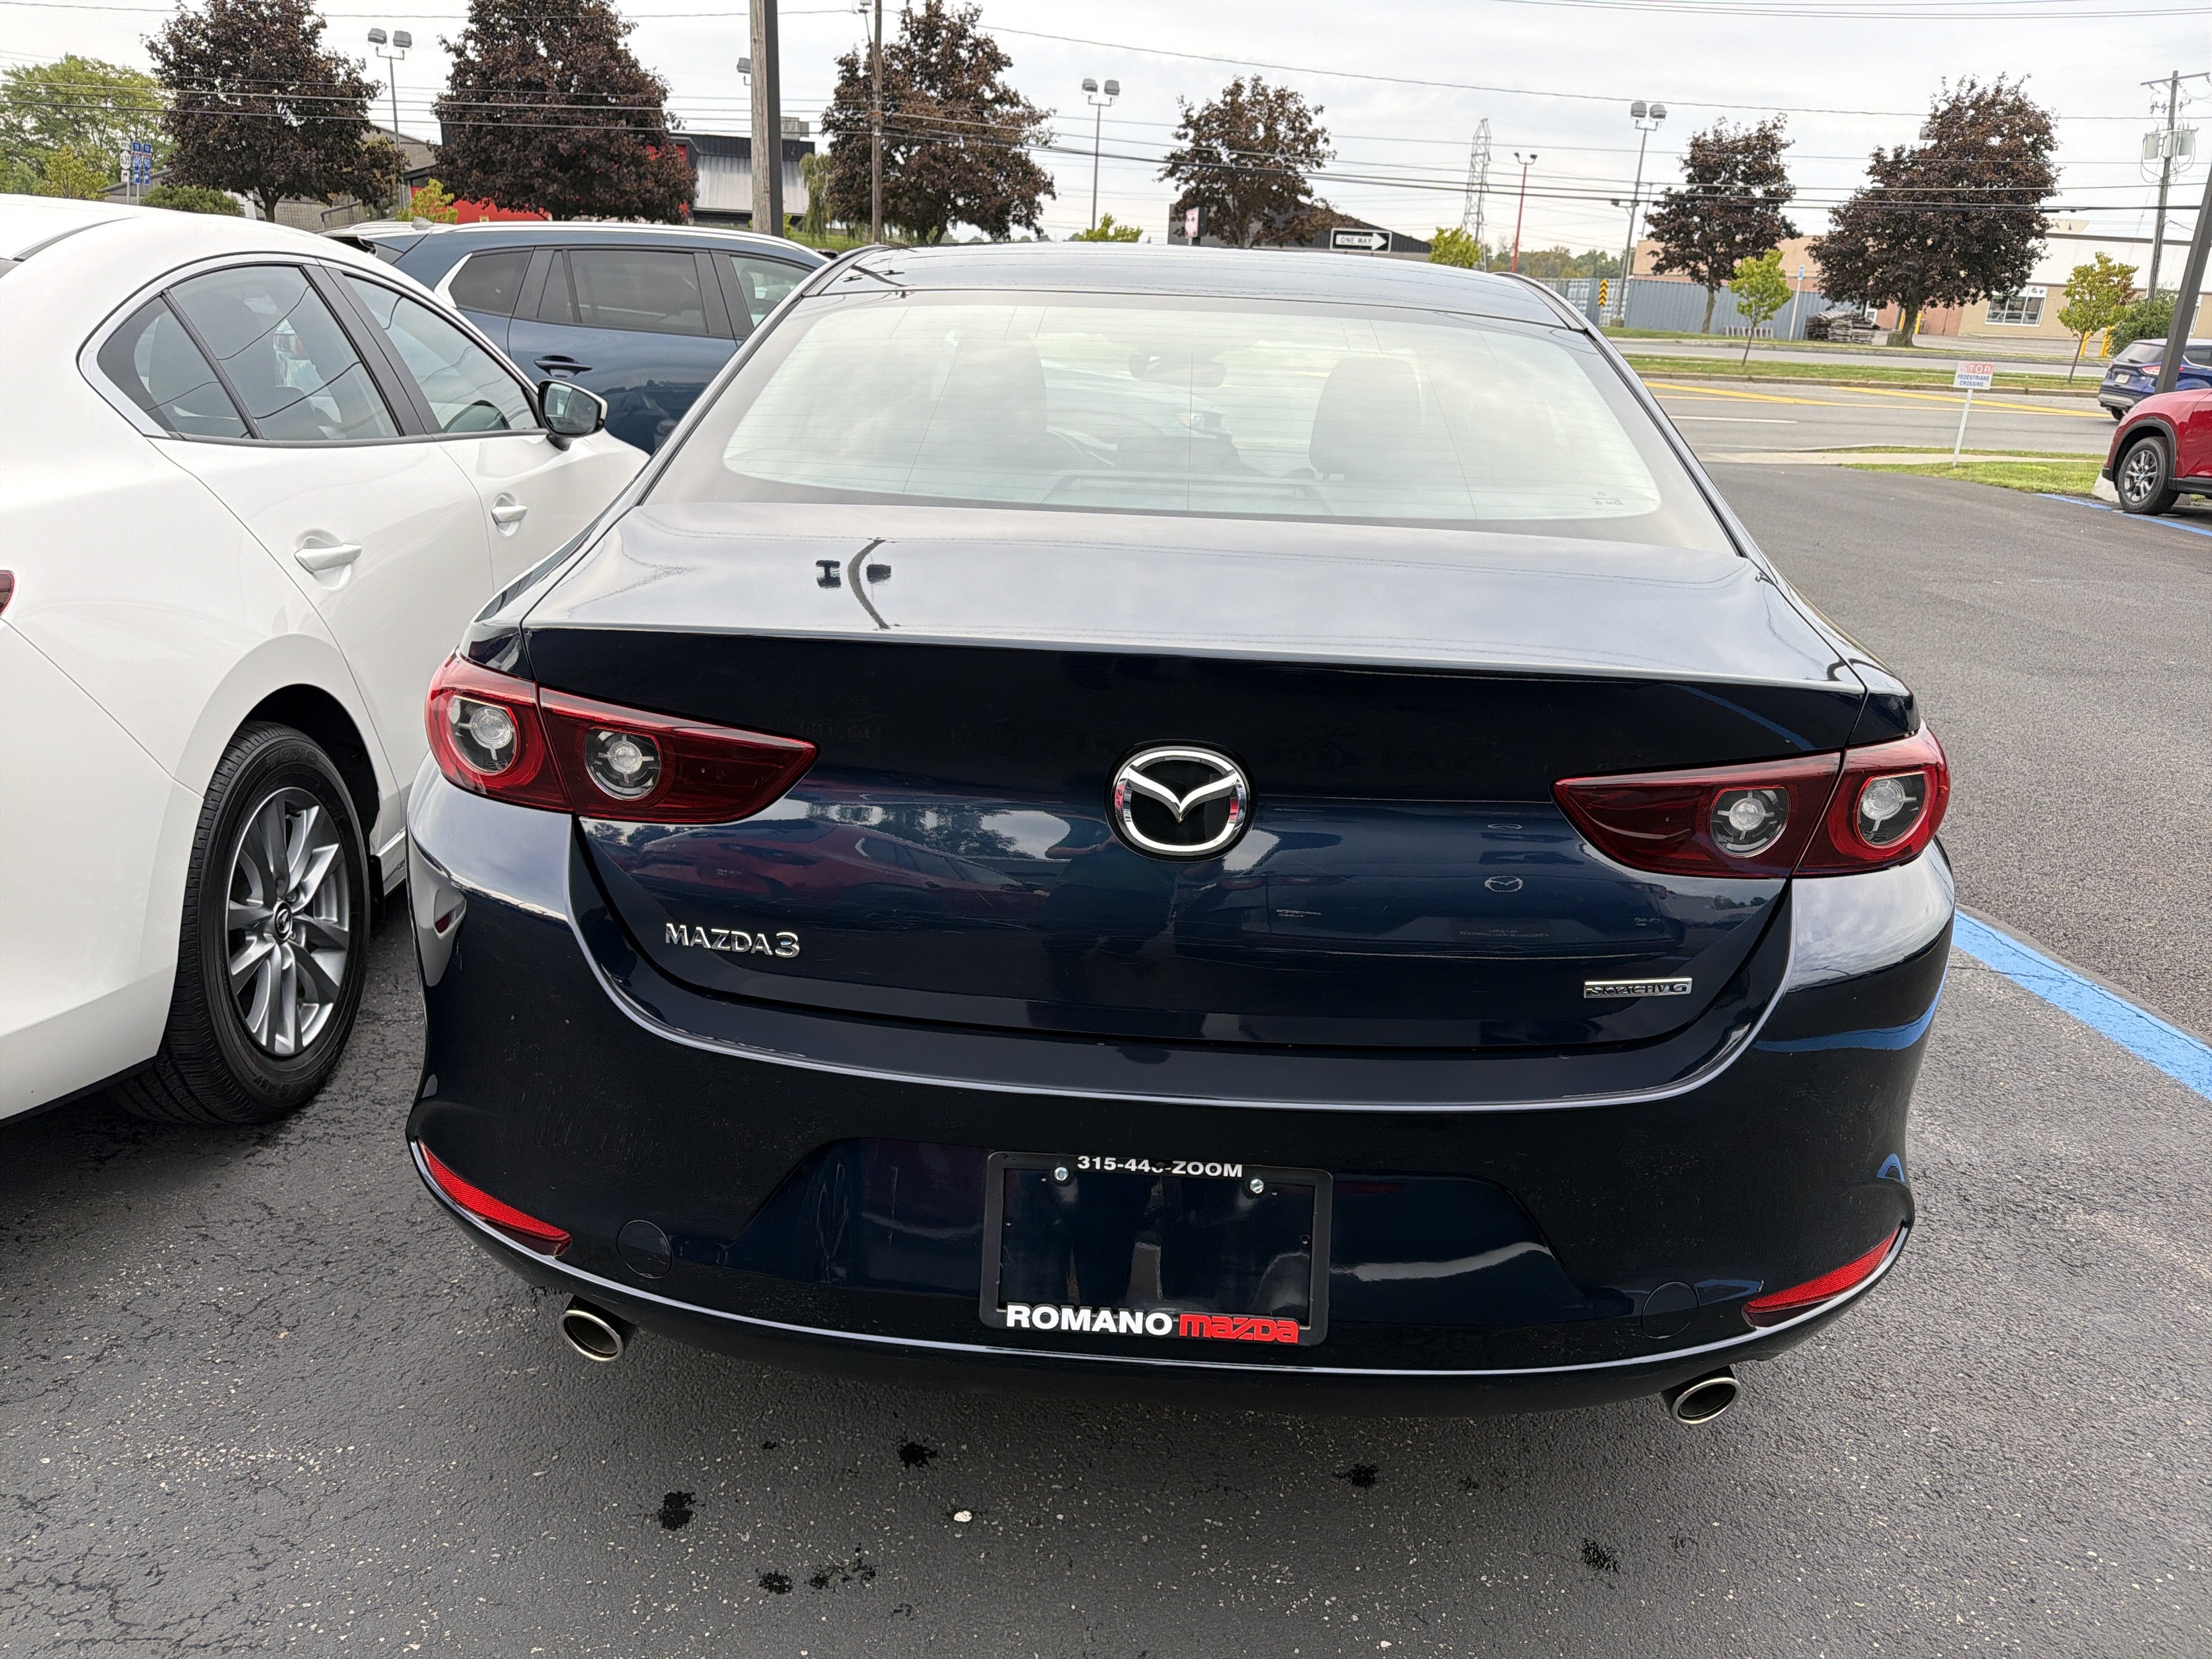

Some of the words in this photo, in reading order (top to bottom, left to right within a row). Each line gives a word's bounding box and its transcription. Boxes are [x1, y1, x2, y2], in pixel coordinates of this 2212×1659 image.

[121, 155, 130, 165] 635
[133, 156, 141, 167] 690
[144, 158, 150, 168] 90
[1961, 364, 1991, 373] STOP
[665, 923, 800, 958] MAZDA3
[1006, 1305, 1173, 1336] ROMANO
